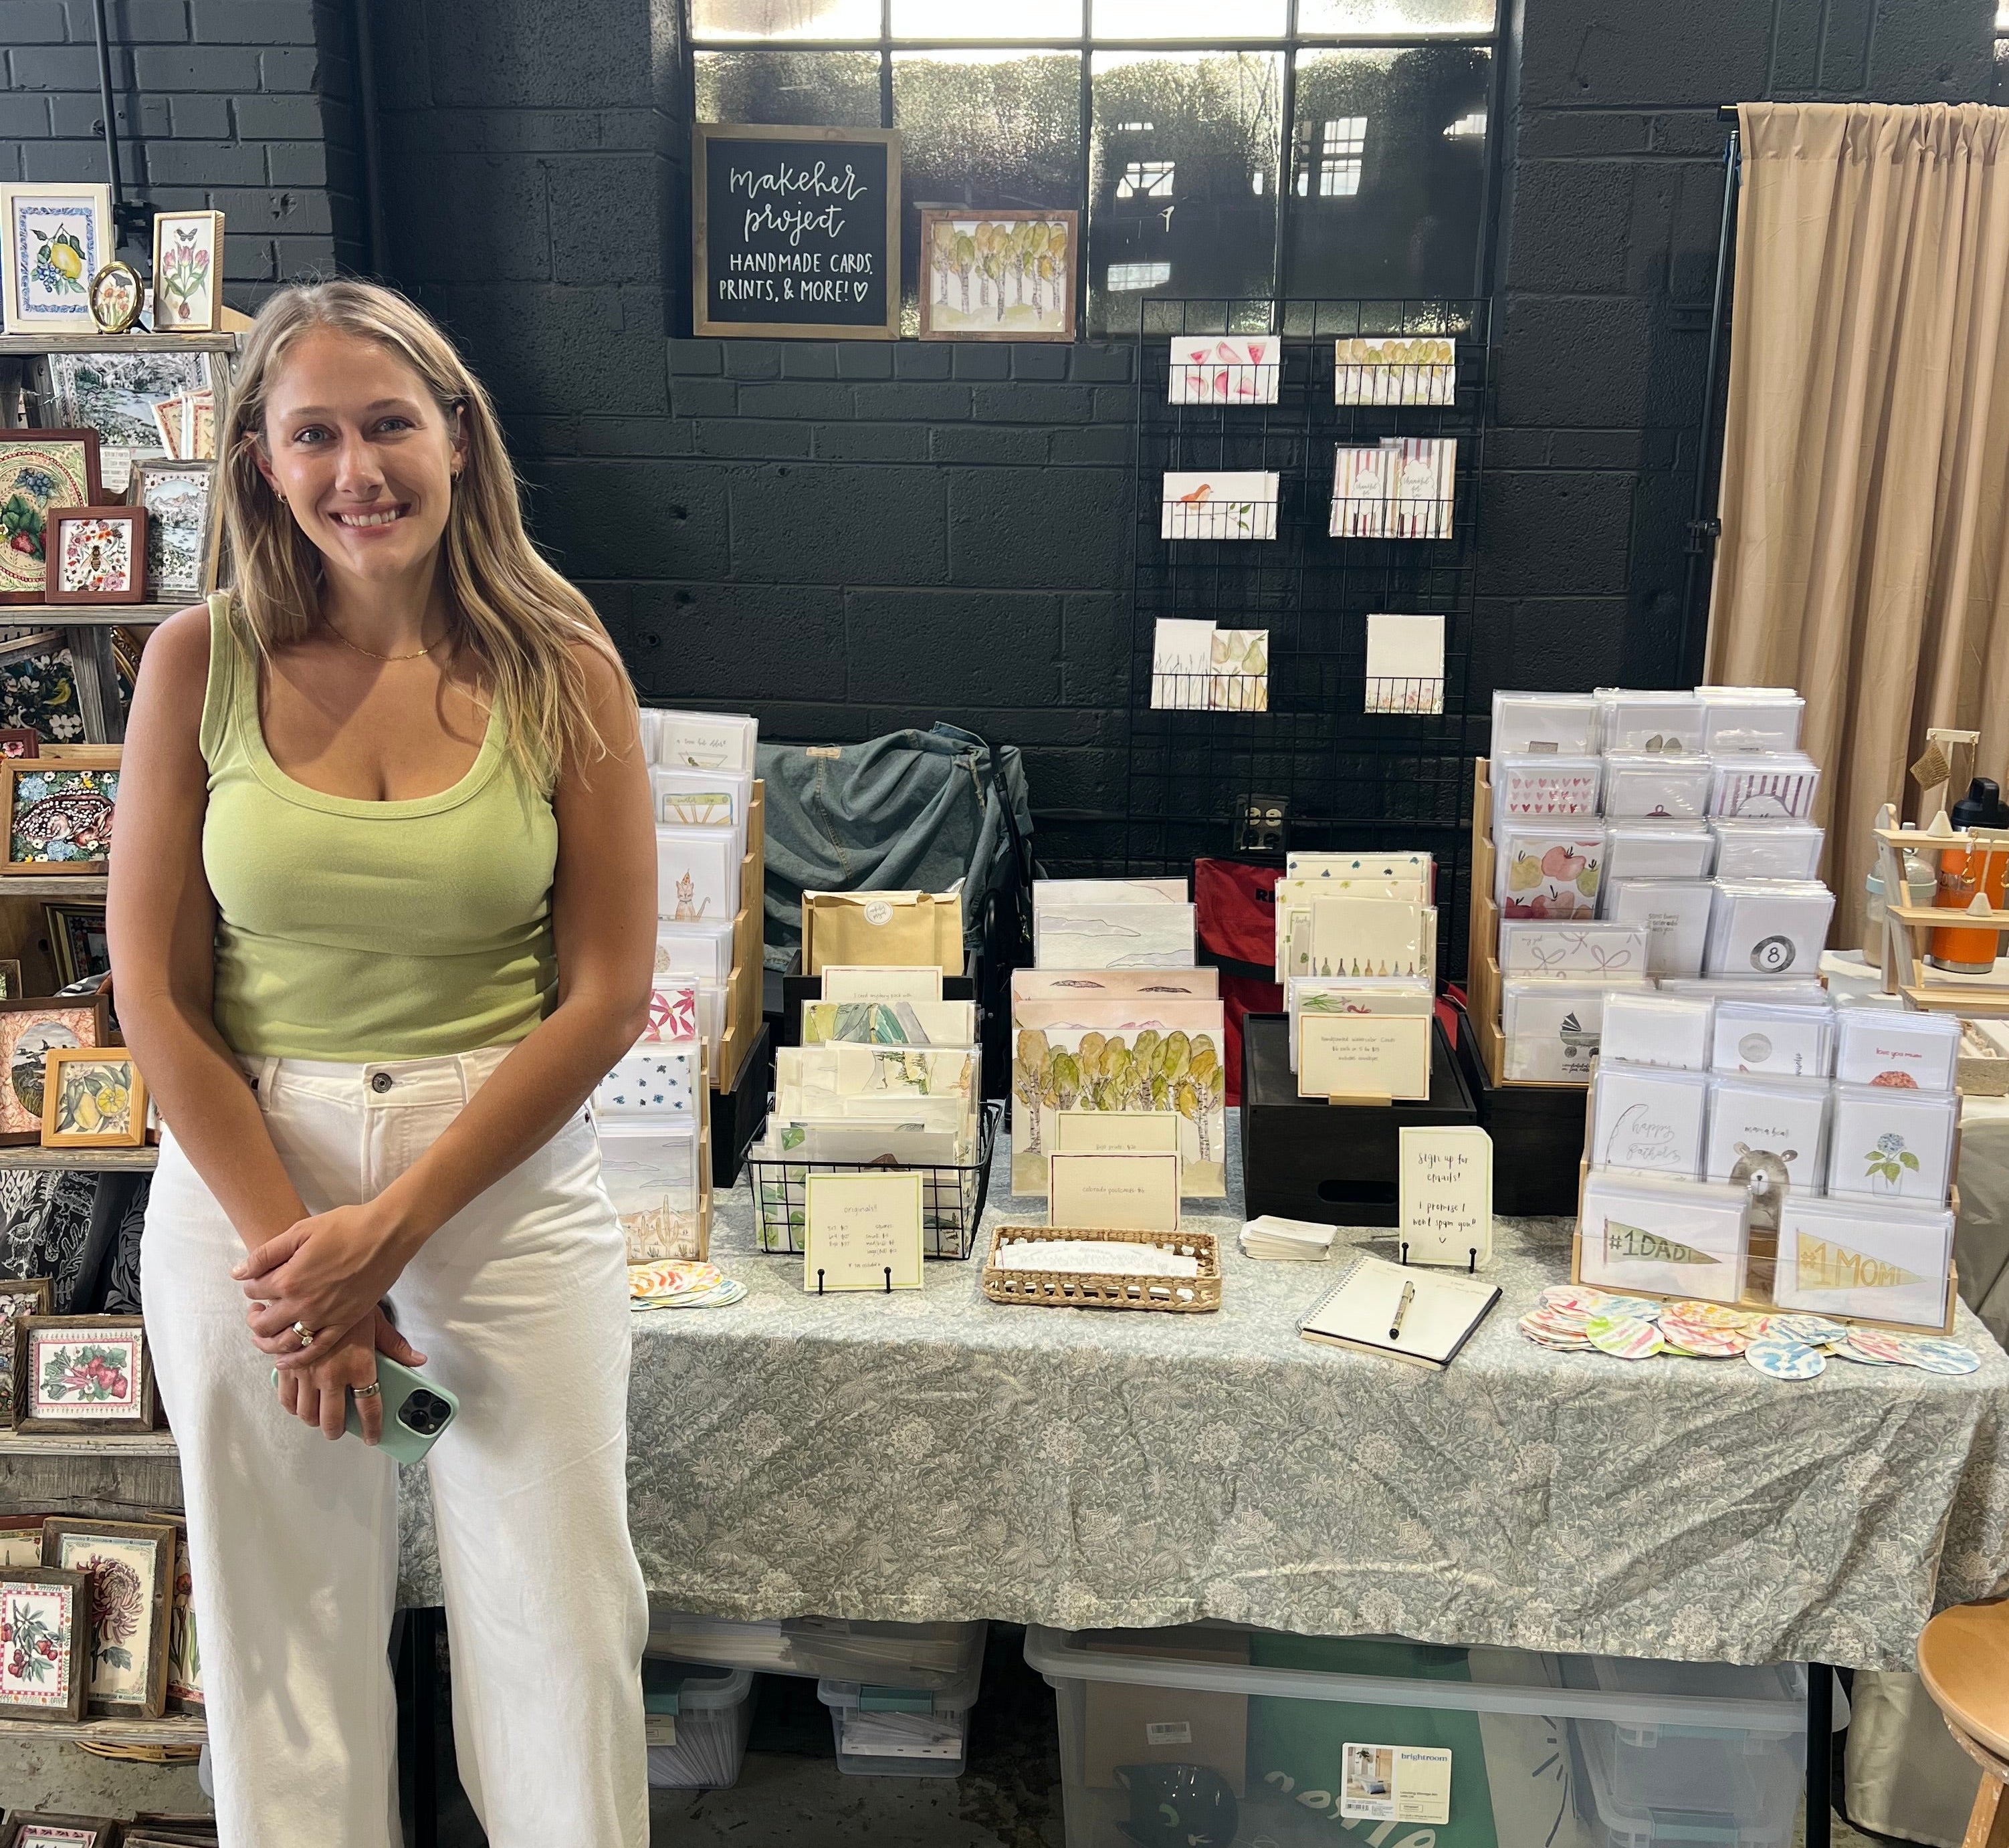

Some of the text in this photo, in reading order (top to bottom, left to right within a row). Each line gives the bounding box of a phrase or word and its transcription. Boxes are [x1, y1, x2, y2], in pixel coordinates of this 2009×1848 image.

[730, 161, 867, 201] makeher
[744, 201, 845, 246] project
[730, 253, 822, 273] HANDMADE
[720, 278, 849, 302] PRINTS, & MORE!
[1768, 947, 1780, 963] 8
[1445, 1155, 1453, 1169] up
[1457, 1154, 1468, 1164] for
[1427, 1203, 1458, 1214] promise
[1435, 1219, 1453, 1230] spam
[1401, 1753, 1448, 1762] brightroom
